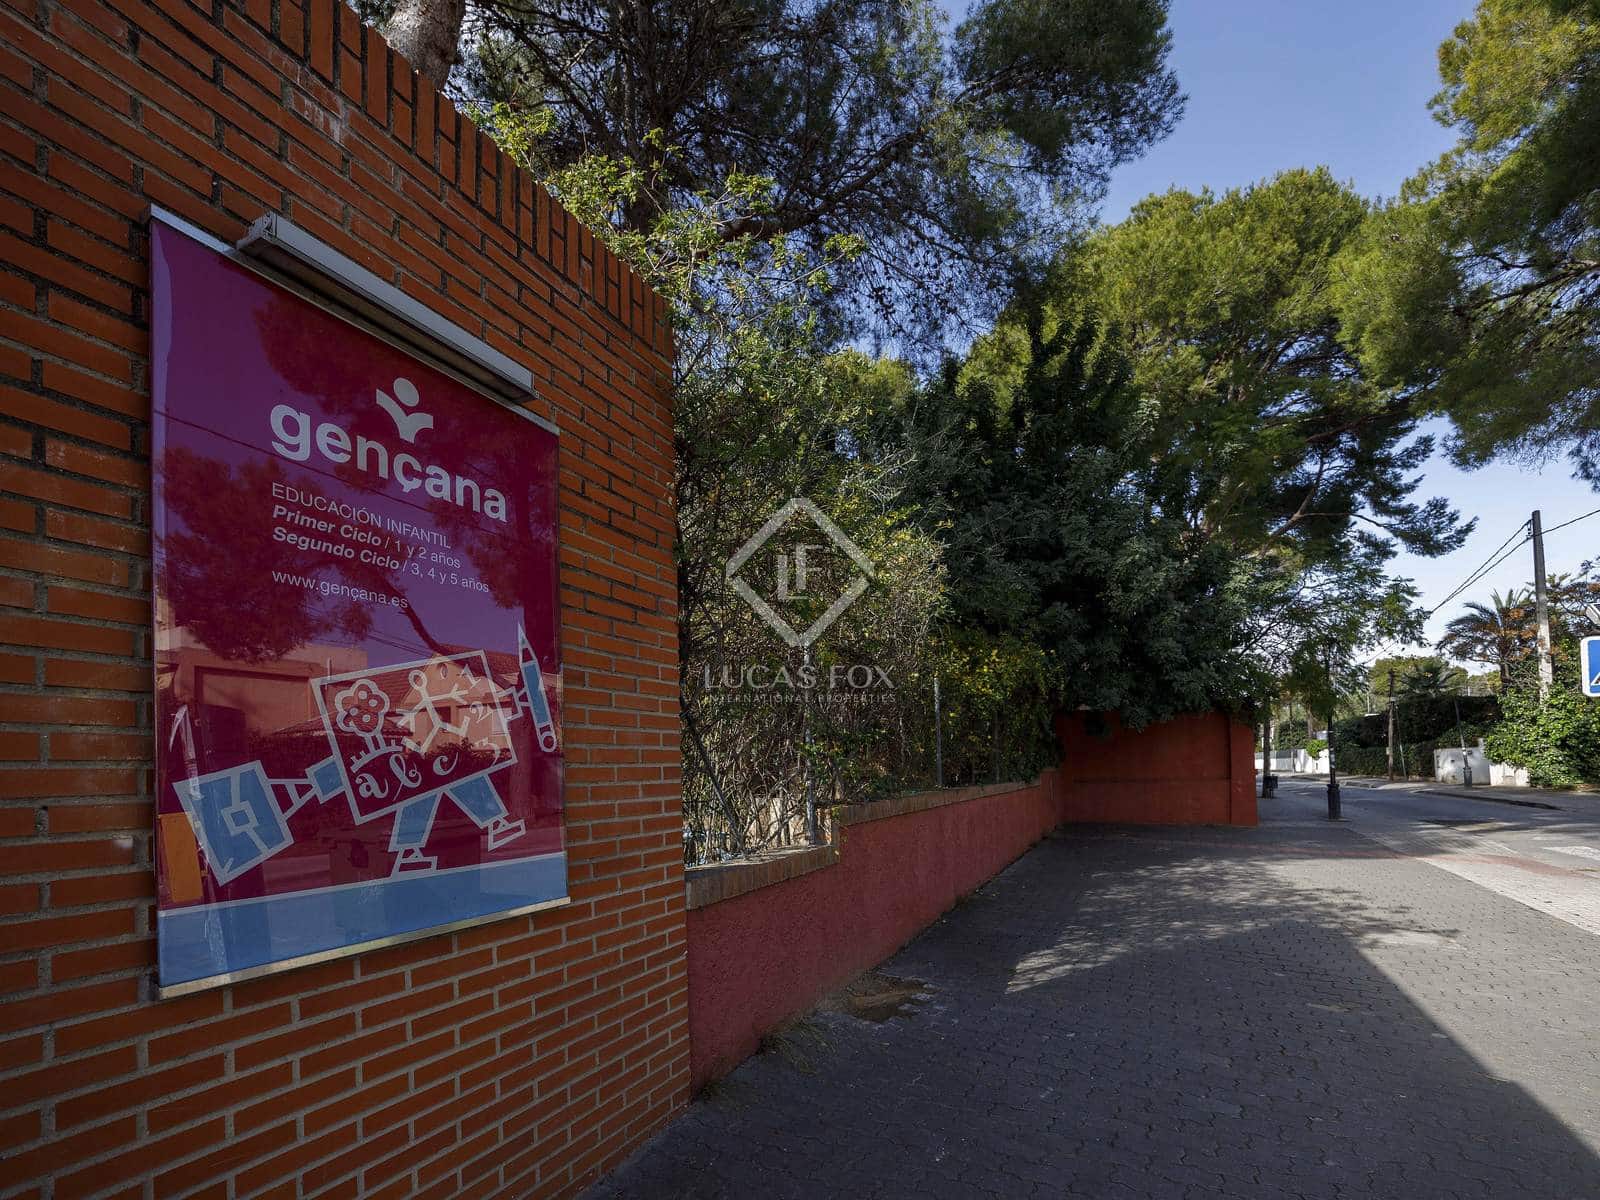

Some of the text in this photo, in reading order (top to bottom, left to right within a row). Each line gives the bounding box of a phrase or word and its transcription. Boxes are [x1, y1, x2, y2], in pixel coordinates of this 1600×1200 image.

[269, 403, 508, 523] gençana
[272, 482, 452, 549] EDUCACIÓN INFANTIL
[272, 504, 336, 533] Primer
[340, 525, 382, 547] Ciclo
[395, 540, 401, 552] 1
[407, 545, 415, 558] y
[418, 546, 427, 559] 2
[431, 552, 461, 569] años
[272, 526, 355, 559] Segundo
[360, 549, 400, 570] Ciclo
[411, 562, 423, 579] 3,
[427, 567, 436, 580] 4
[440, 572, 447, 584] y
[450, 573, 458, 585] 5
[461, 578, 489, 593] años
[272, 570, 409, 609] www.gençana.es
